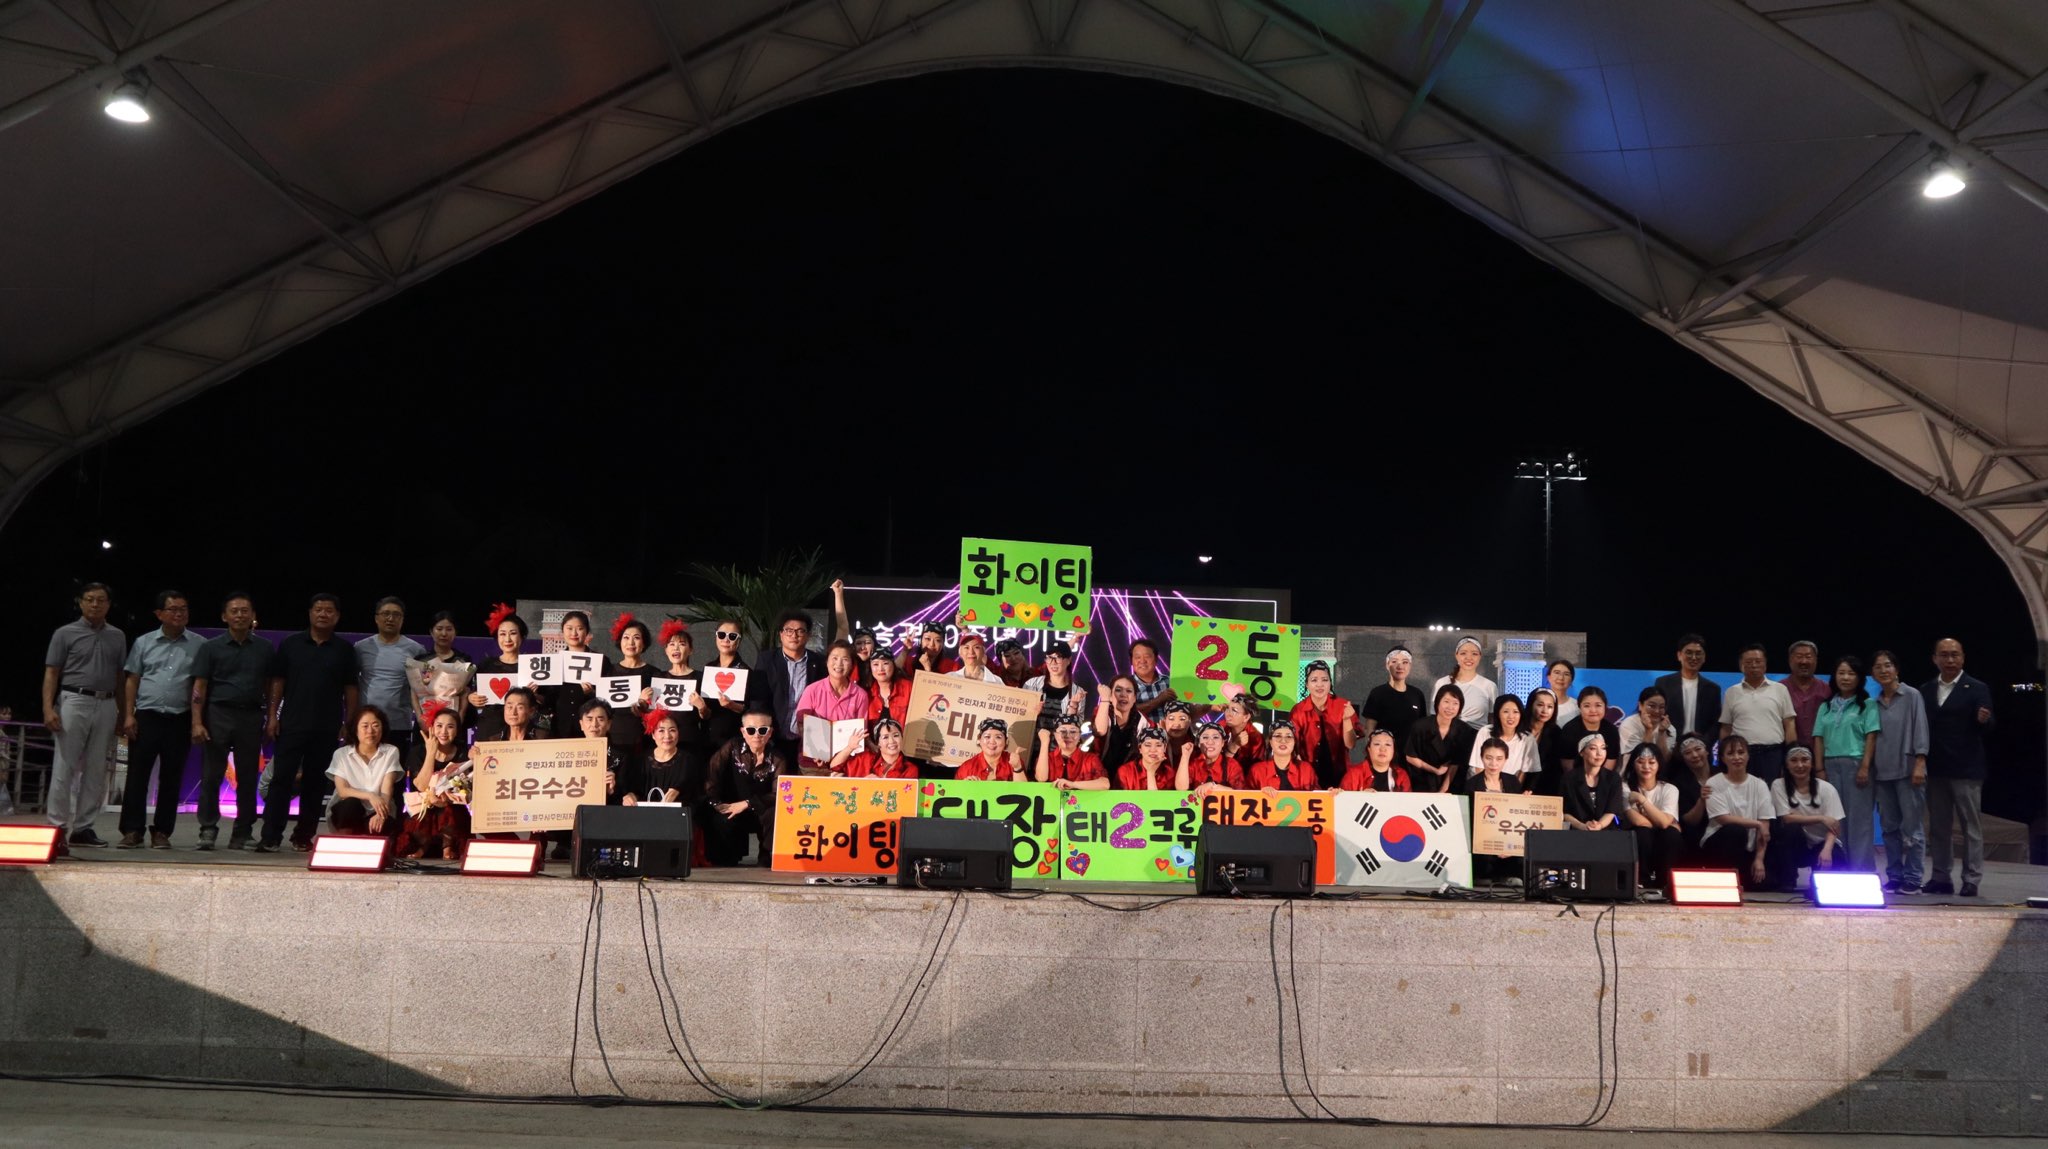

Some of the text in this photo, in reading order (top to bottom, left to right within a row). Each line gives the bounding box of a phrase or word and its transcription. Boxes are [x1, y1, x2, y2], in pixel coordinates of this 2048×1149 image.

[968, 547, 1086, 611] 화이팅
[1195, 631, 1283, 701] 2동
[957, 696, 1027, 717] 주민자치 화합 한마당
[987, 694, 1029, 708] 2025 원주시
[525, 759, 598, 770] 주민자치 화합 한마당
[555, 750, 598, 759] 2025 원주시
[495, 776, 588, 800] 최우수상
[1066, 802, 1199, 849] 태2크루
[794, 821, 898, 869] 화이팅
